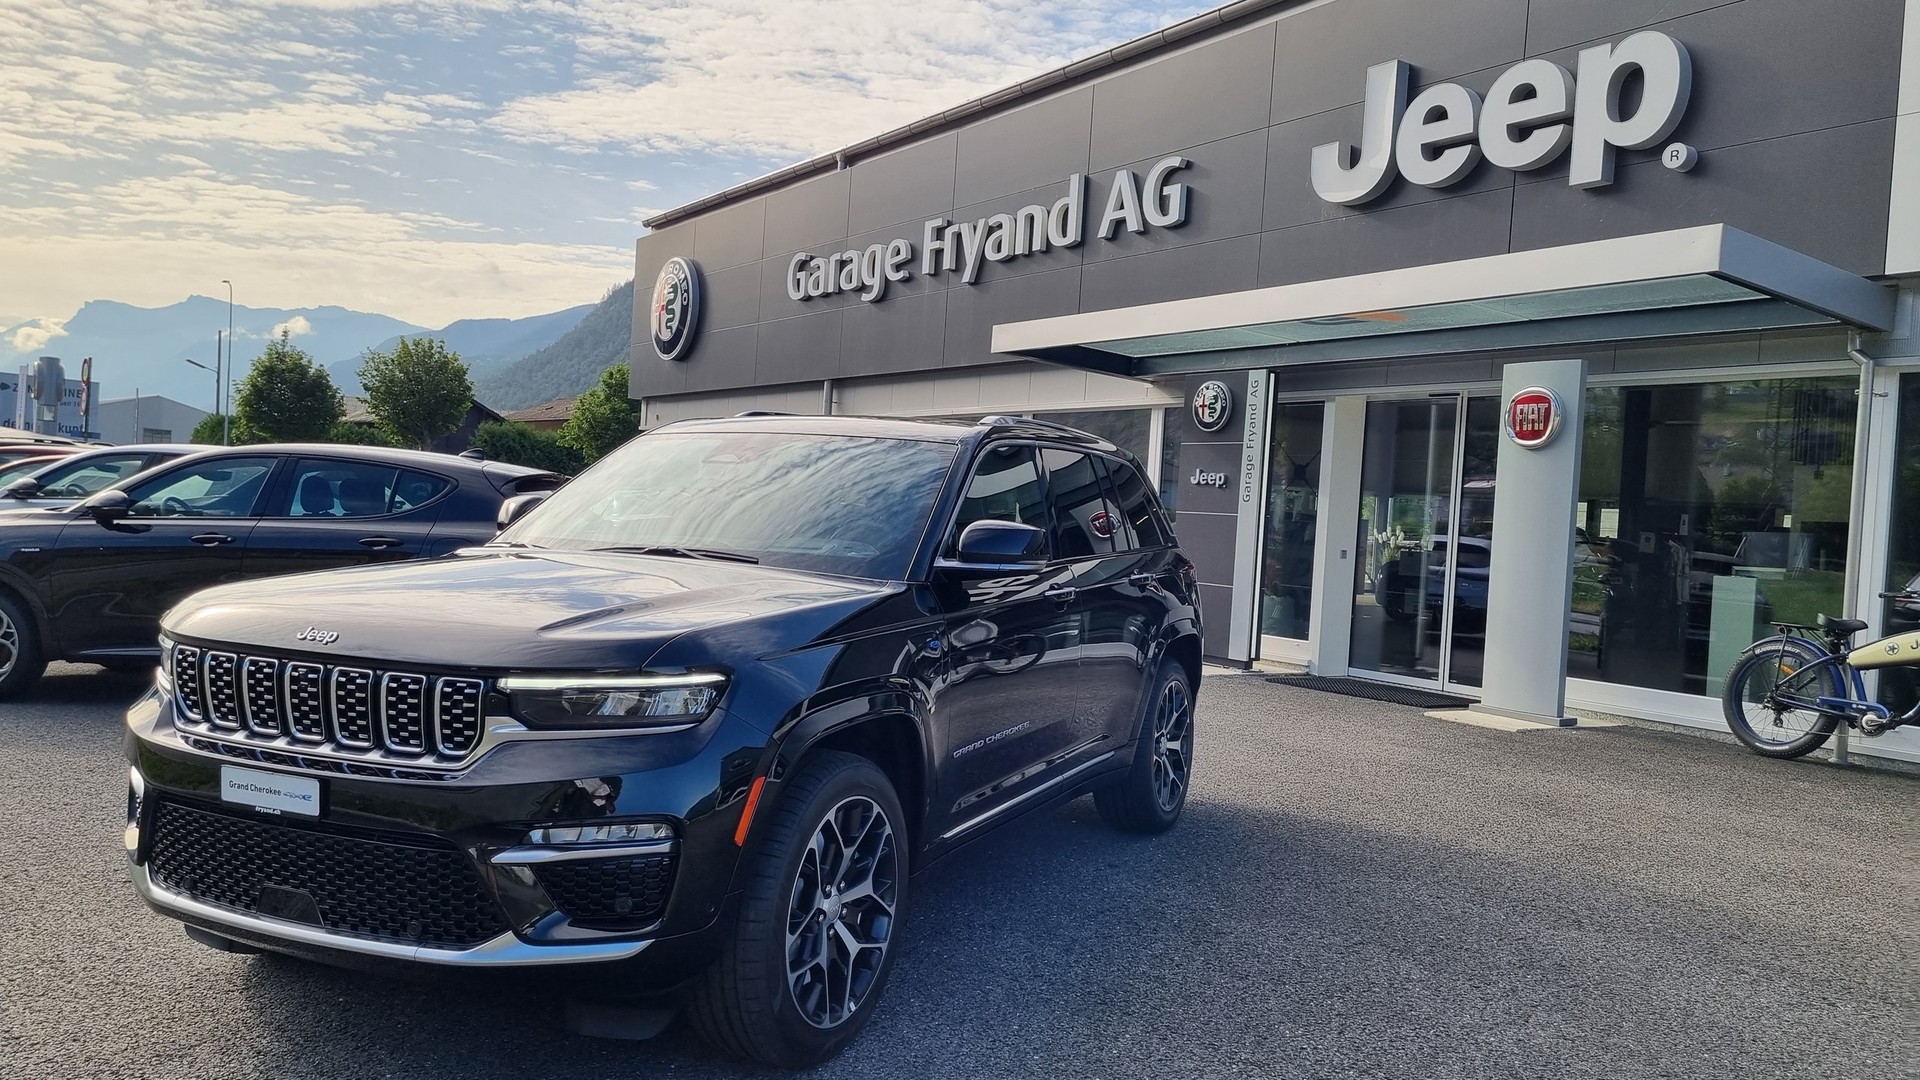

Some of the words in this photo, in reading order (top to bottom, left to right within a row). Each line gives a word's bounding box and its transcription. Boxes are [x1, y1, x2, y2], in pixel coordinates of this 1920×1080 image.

[1311, 30, 1690, 204] Jeep
[786, 238, 912, 302] Garage
[921, 172, 1086, 284] Fryand
[1097, 156, 1189, 240] AG
[1250, 380, 1260, 399] AG
[1246, 403, 1258, 449] Fryand
[1515, 403, 1549, 431] FIAT
[1190, 468, 1225, 488] Jeep
[1242, 454, 1256, 503] Garage
[296, 626, 339, 646] Jeep
[953, 740, 985, 758] GRAND
[986, 721, 1030, 744] CHEROKEE
[229, 780, 249, 792] Grand
[250, 783, 282, 797] Cherokee
